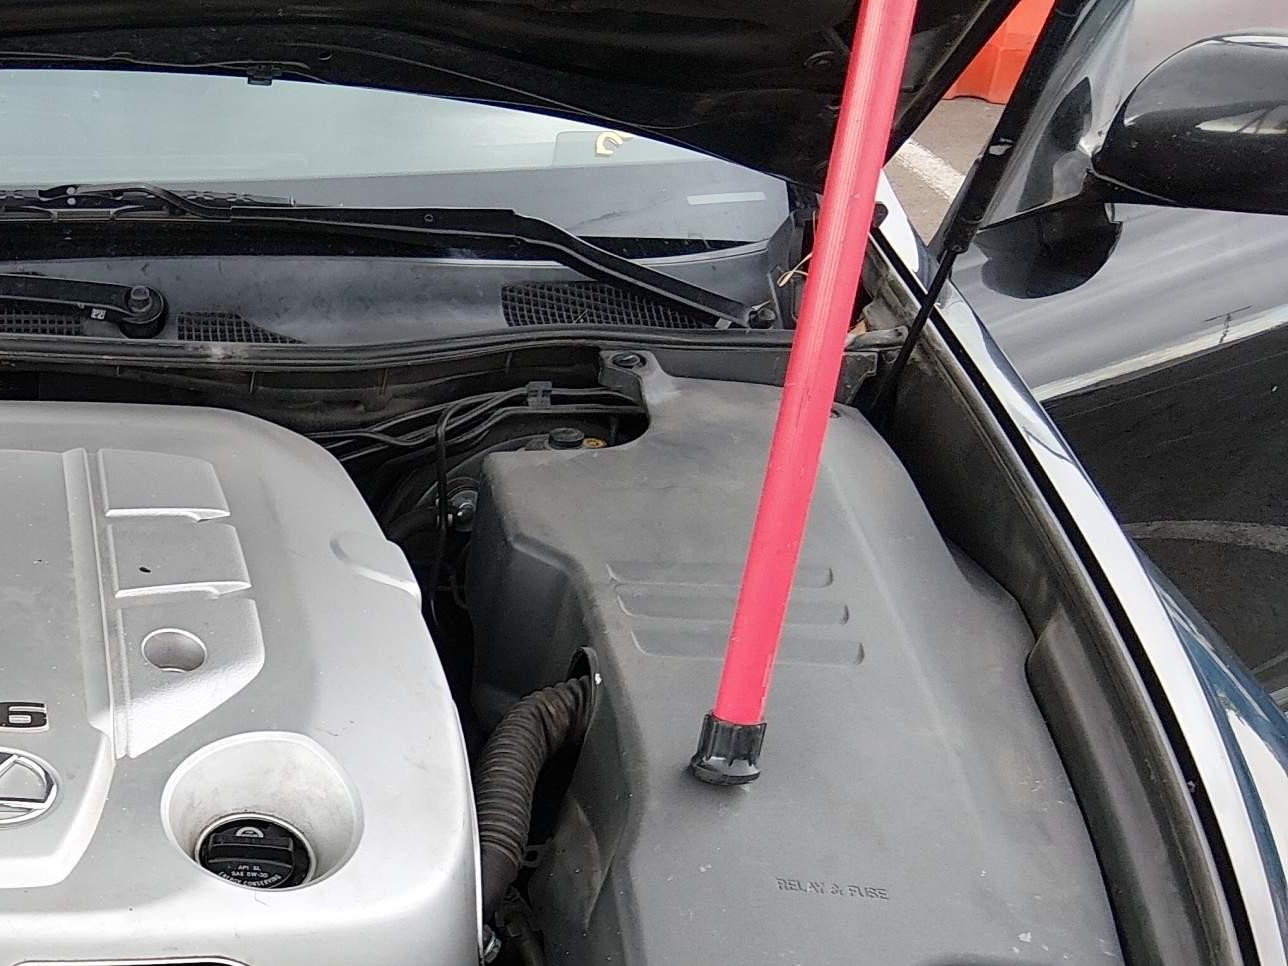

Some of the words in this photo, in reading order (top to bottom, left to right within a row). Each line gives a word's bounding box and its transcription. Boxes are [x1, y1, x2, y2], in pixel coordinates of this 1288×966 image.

[775, 877, 825, 895] RELAY
[830, 882, 844, 896] &
[847, 884, 890, 901] FUSE
